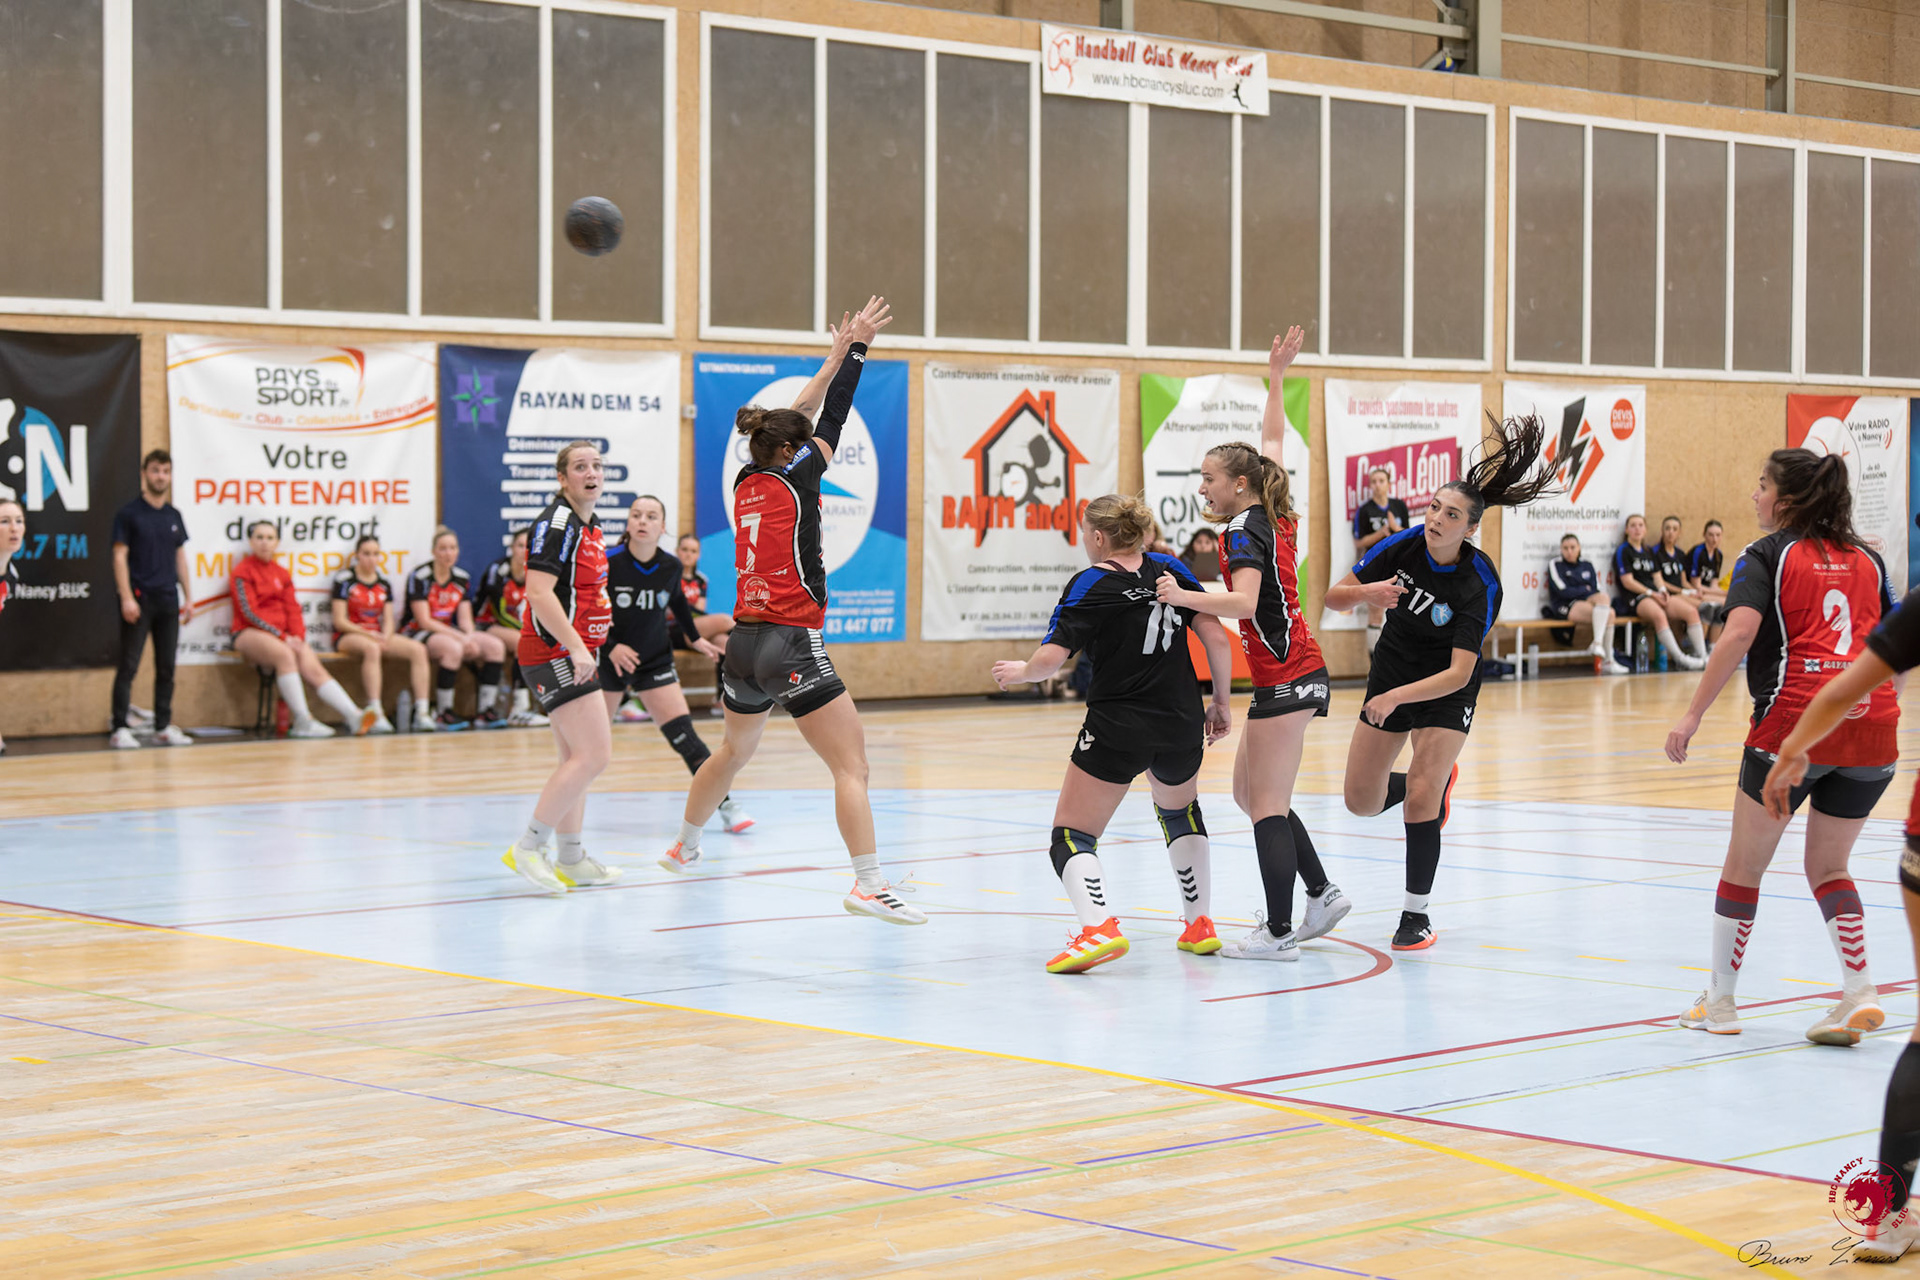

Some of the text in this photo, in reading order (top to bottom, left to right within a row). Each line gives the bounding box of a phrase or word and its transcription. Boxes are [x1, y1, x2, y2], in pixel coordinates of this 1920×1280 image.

[1075, 36, 1136, 64] Handball
[1142, 44, 1175, 69] Club
[1180, 50, 1220, 80] Nancy
[1091, 71, 1224, 99] www.hbcnancysluc.com
[257, 367, 320, 386] PAYS
[931, 367, 1112, 387] Construisons ensemble votre avenir
[519, 391, 662, 412] RAYAN DEM 54
[1867, 417, 1890, 430] RADIO
[1861, 430, 1883, 443] Nancy
[262, 443, 348, 470] Votre
[1406, 443, 1451, 499] Léon
[194, 479, 410, 505] PARTENAIRE
[1526, 505, 1621, 521] HelloHomeLorraine
[55, 533, 90, 560] FM
[1522, 571, 1539, 590] 06
[14, 582, 57, 603] Nancy
[636, 589, 655, 610] 41
[1407, 587, 1435, 616] 17
